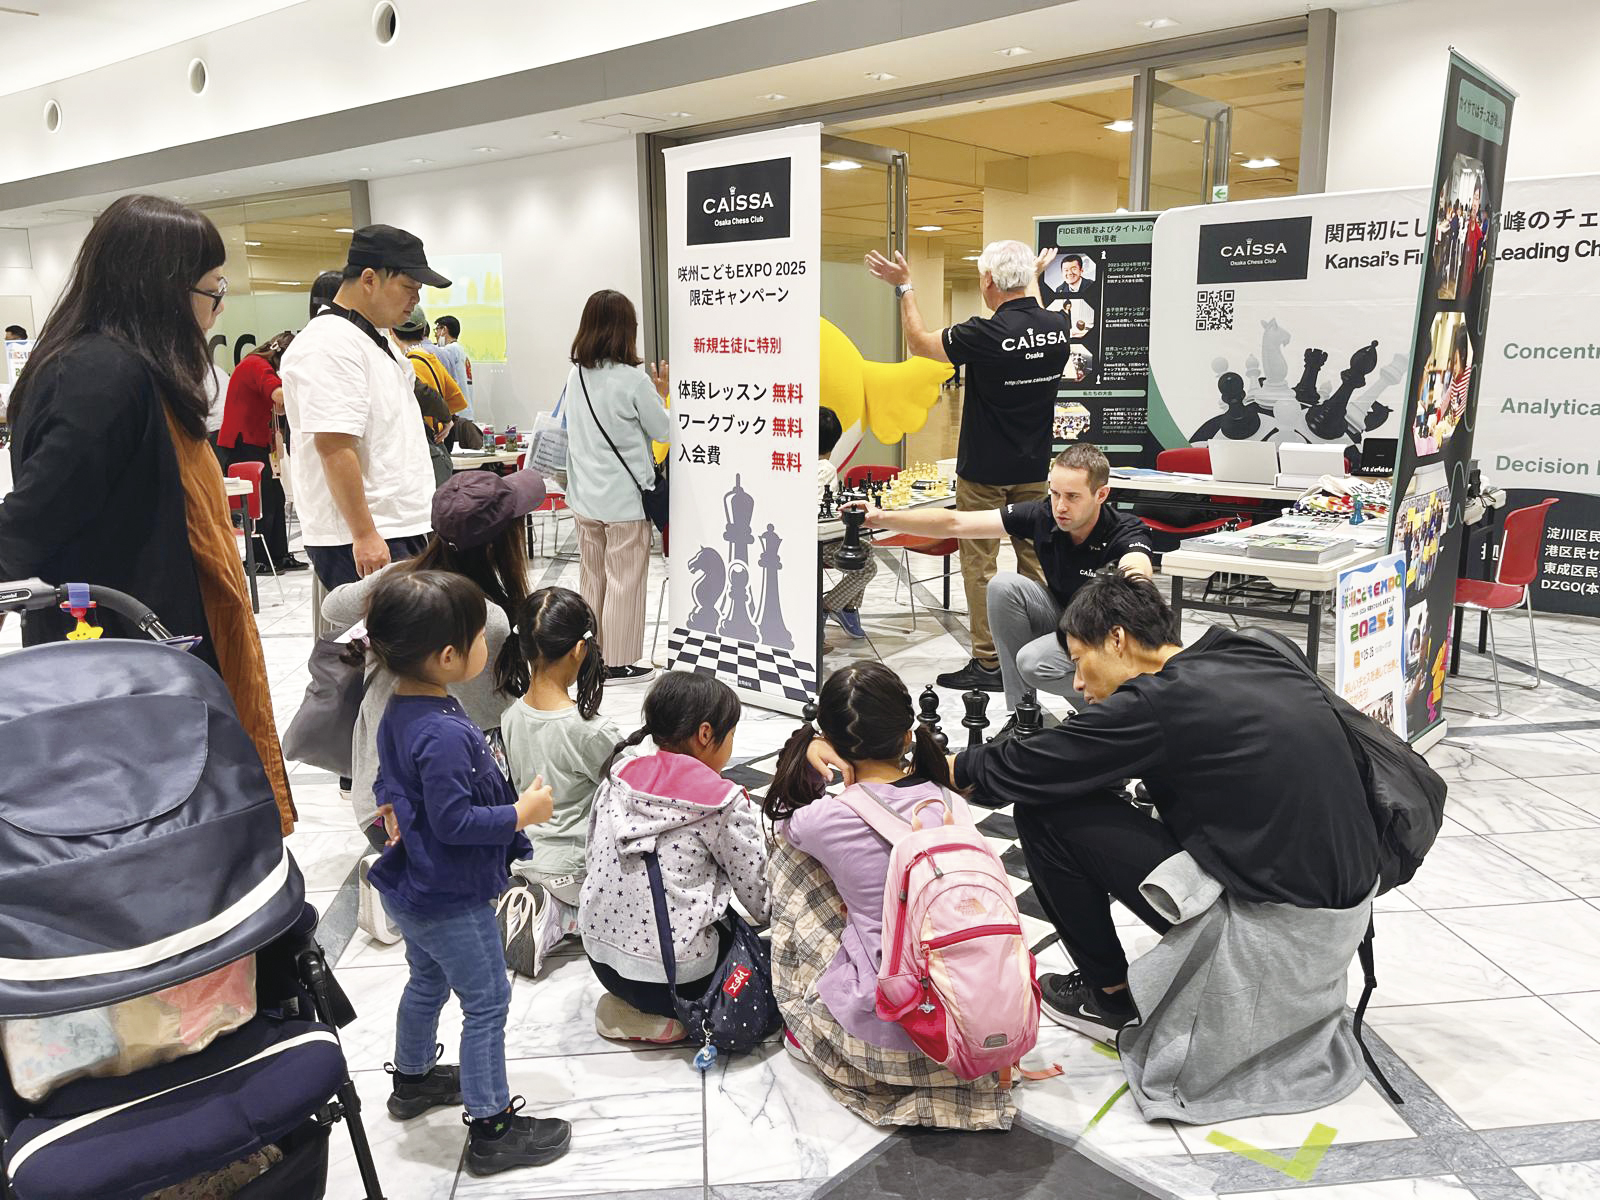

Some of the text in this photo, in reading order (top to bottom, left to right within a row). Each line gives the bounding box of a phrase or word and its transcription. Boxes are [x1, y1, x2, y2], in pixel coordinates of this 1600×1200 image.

[703, 191, 774, 214] CAISSA
[714, 215, 764, 227] Osaka Chess Club
[1500, 208, 1599, 233] 峰のチェ
[1220, 242, 1288, 258] CAISSA
[1495, 242, 1570, 262] eading
[775, 261, 806, 276] 2025
[689, 287, 789, 307] 限定キャンペーン
[693, 337, 782, 354] 新規生徒に特別
[1001, 330, 1067, 351] CAISSA
[1025, 351, 1044, 360] Osaka
[678, 380, 803, 404] 体験レッスン 無料
[1500, 398, 1600, 419] Analytica
[678, 413, 803, 438] ワークブック 無料
[678, 443, 802, 473] 入会費 無料
[1496, 455, 1589, 475] Decision
[1543, 562, 1600, 578] 東成区民
[1350, 611, 1387, 643] 2025
